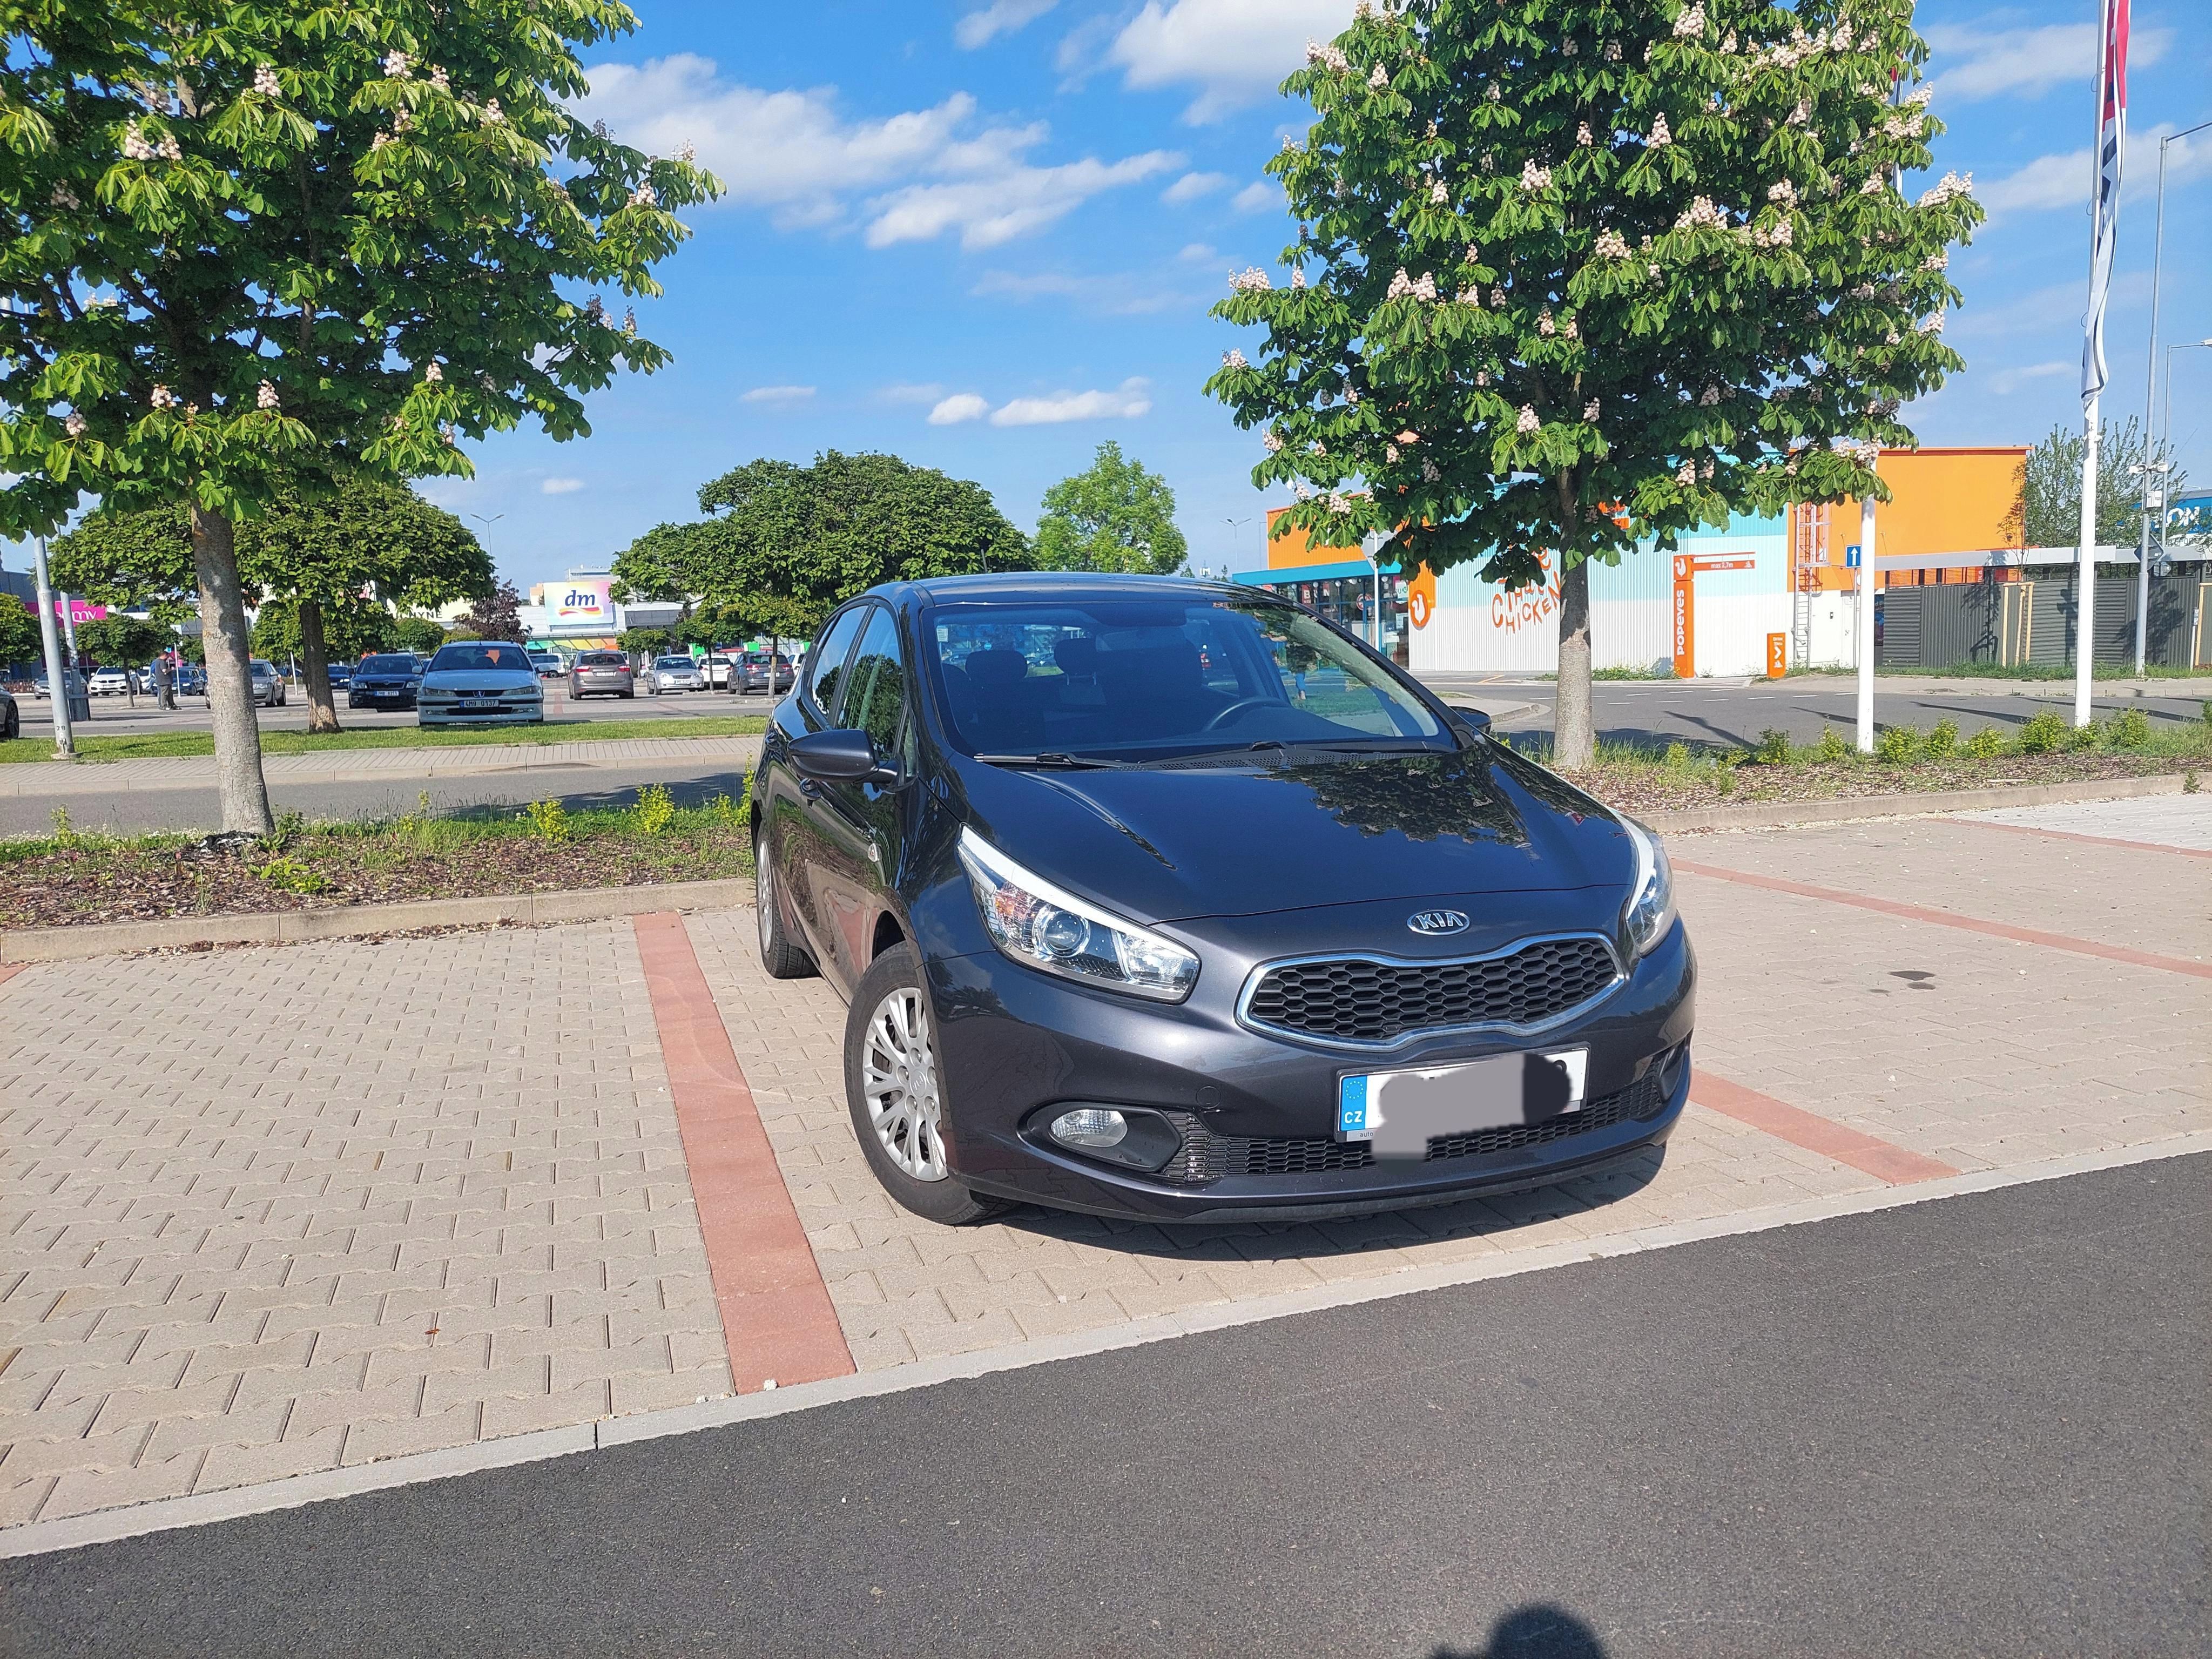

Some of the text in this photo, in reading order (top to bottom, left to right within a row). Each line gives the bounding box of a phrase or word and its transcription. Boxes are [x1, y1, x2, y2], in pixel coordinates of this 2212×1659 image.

[565, 590, 595, 606] dm
[1492, 570, 1561, 636] CHICKEN
[1415, 913, 1464, 929] KIA
[1345, 1110, 1363, 1124] CZ
